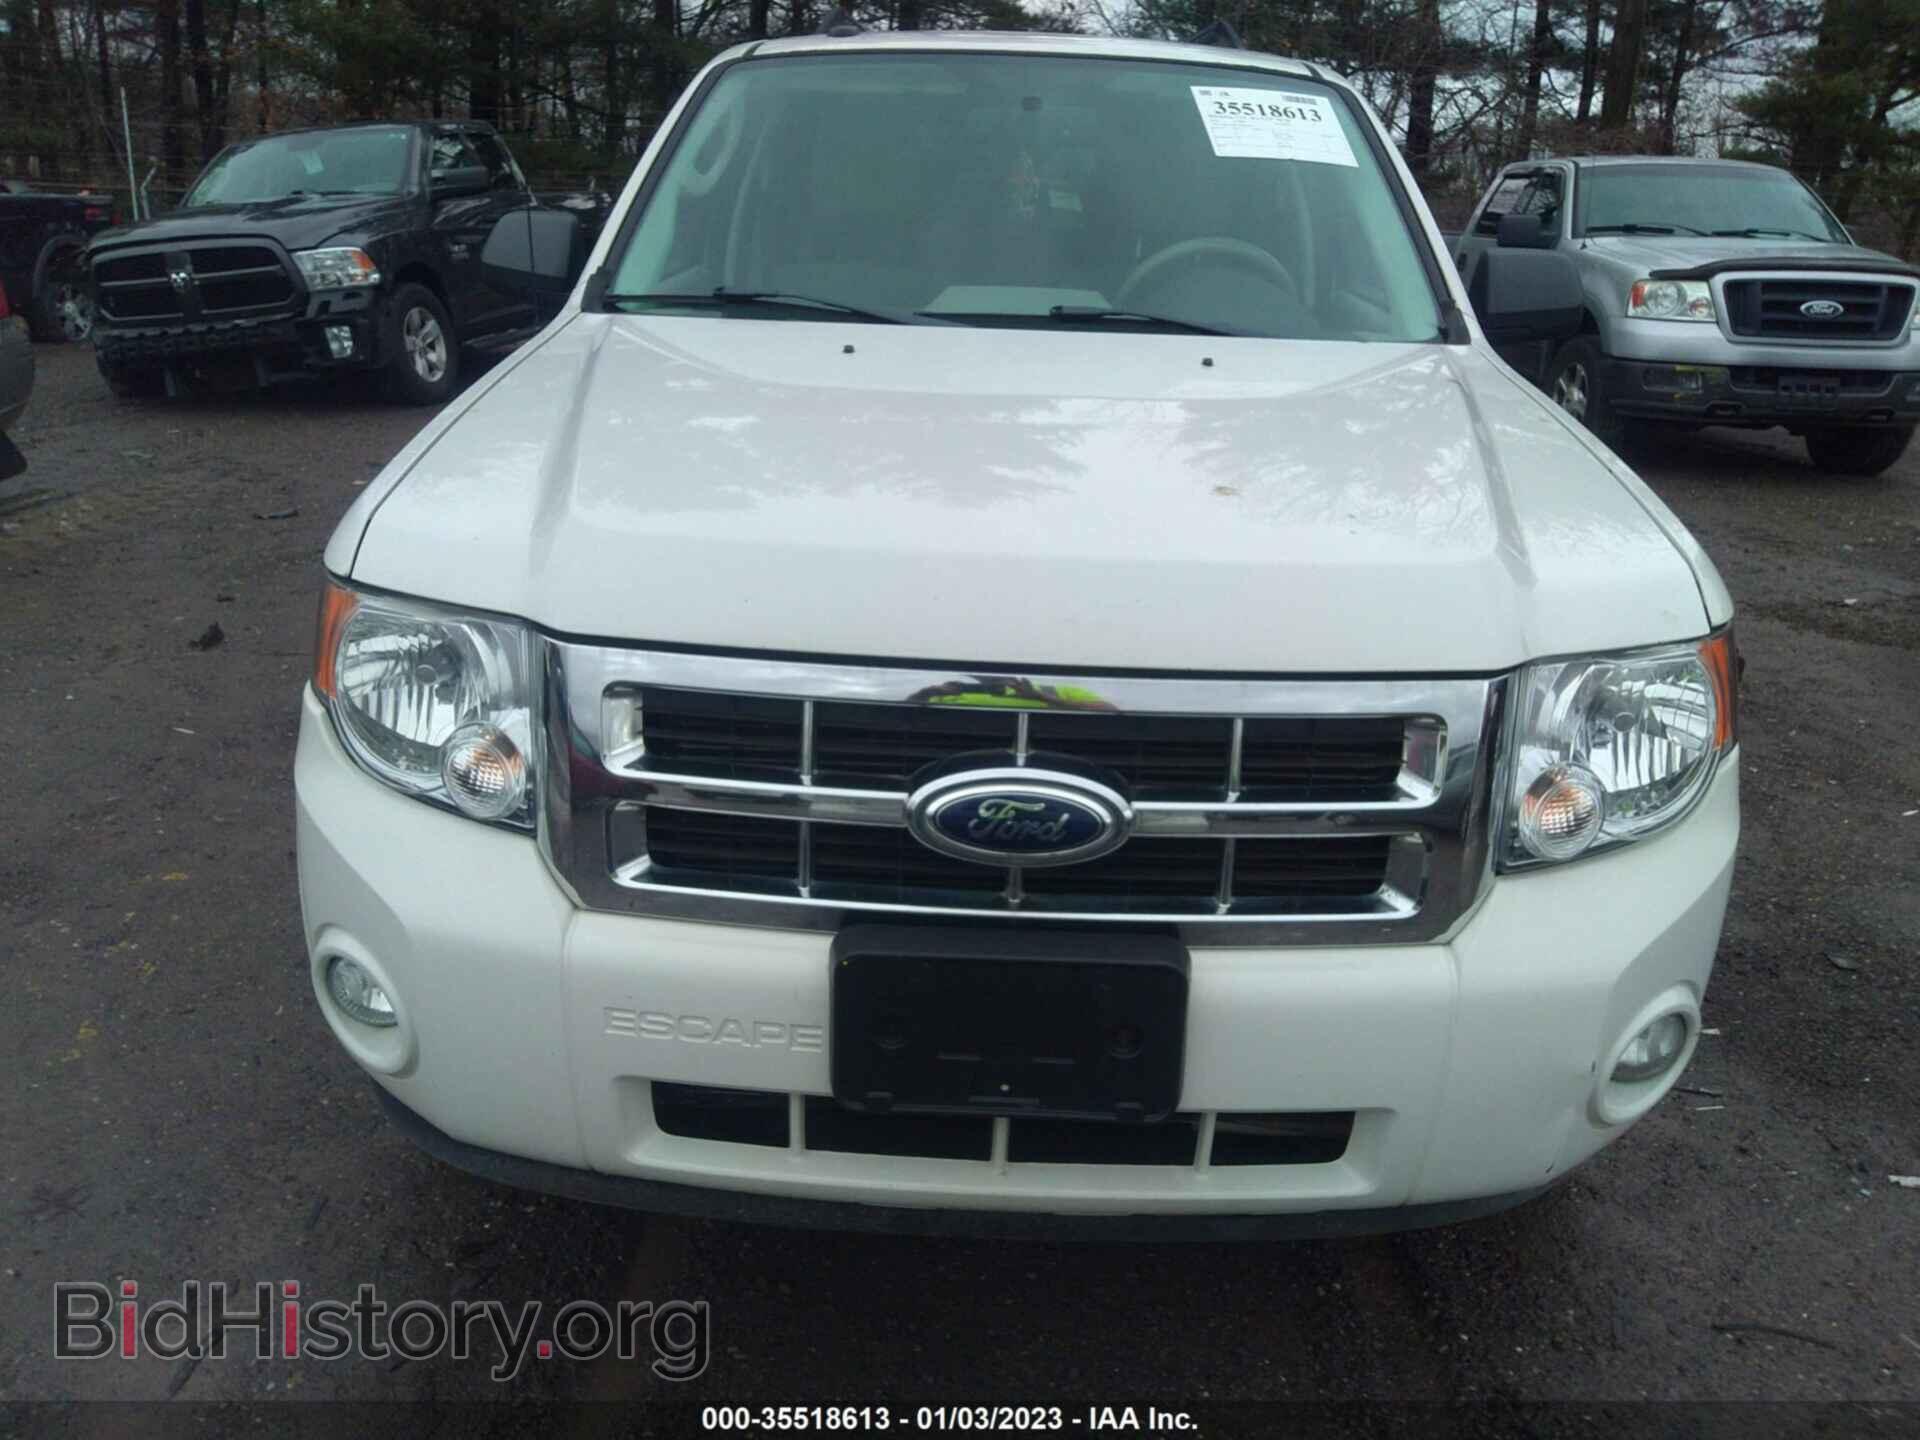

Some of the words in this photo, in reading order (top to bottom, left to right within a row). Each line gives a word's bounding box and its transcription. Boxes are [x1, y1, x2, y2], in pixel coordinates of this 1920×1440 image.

[1214, 101, 1323, 122] 35518613
[967, 798, 1070, 841] Ford
[603, 1006, 824, 1053] ESCAPE
